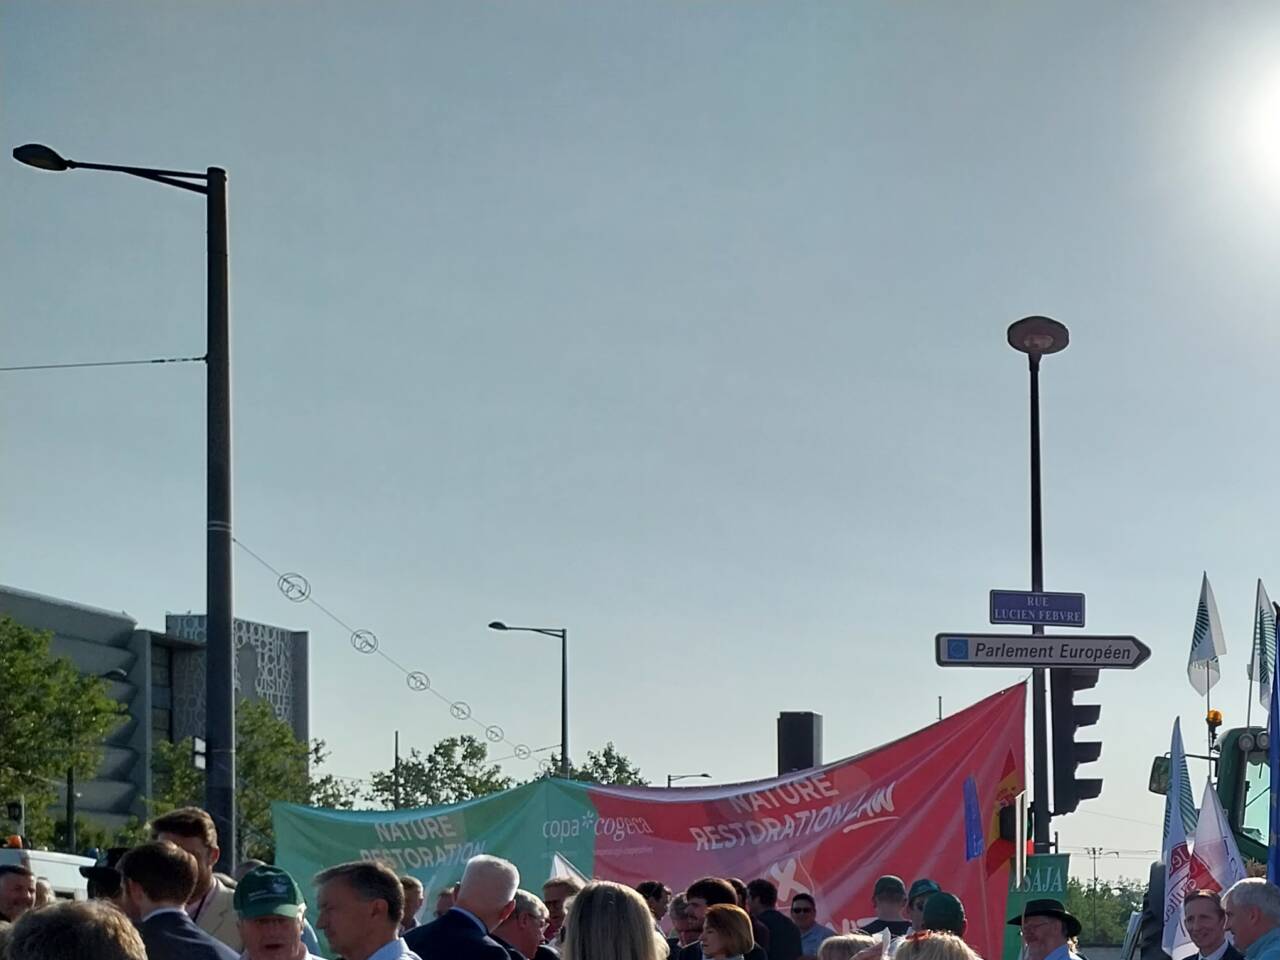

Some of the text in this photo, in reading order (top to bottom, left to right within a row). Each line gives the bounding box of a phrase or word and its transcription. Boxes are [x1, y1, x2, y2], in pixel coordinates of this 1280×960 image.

[994, 608, 1082, 622] LUCIEN FEBVRE
[1027, 597, 1049, 607] RUE
[974, 642, 1132, 662] Parlement Européen
[727, 773, 840, 814] NATURE
[374, 815, 456, 843] NATURE
[543, 815, 654, 843] copa cogeca
[689, 780, 896, 852] RESTORATION LAW
